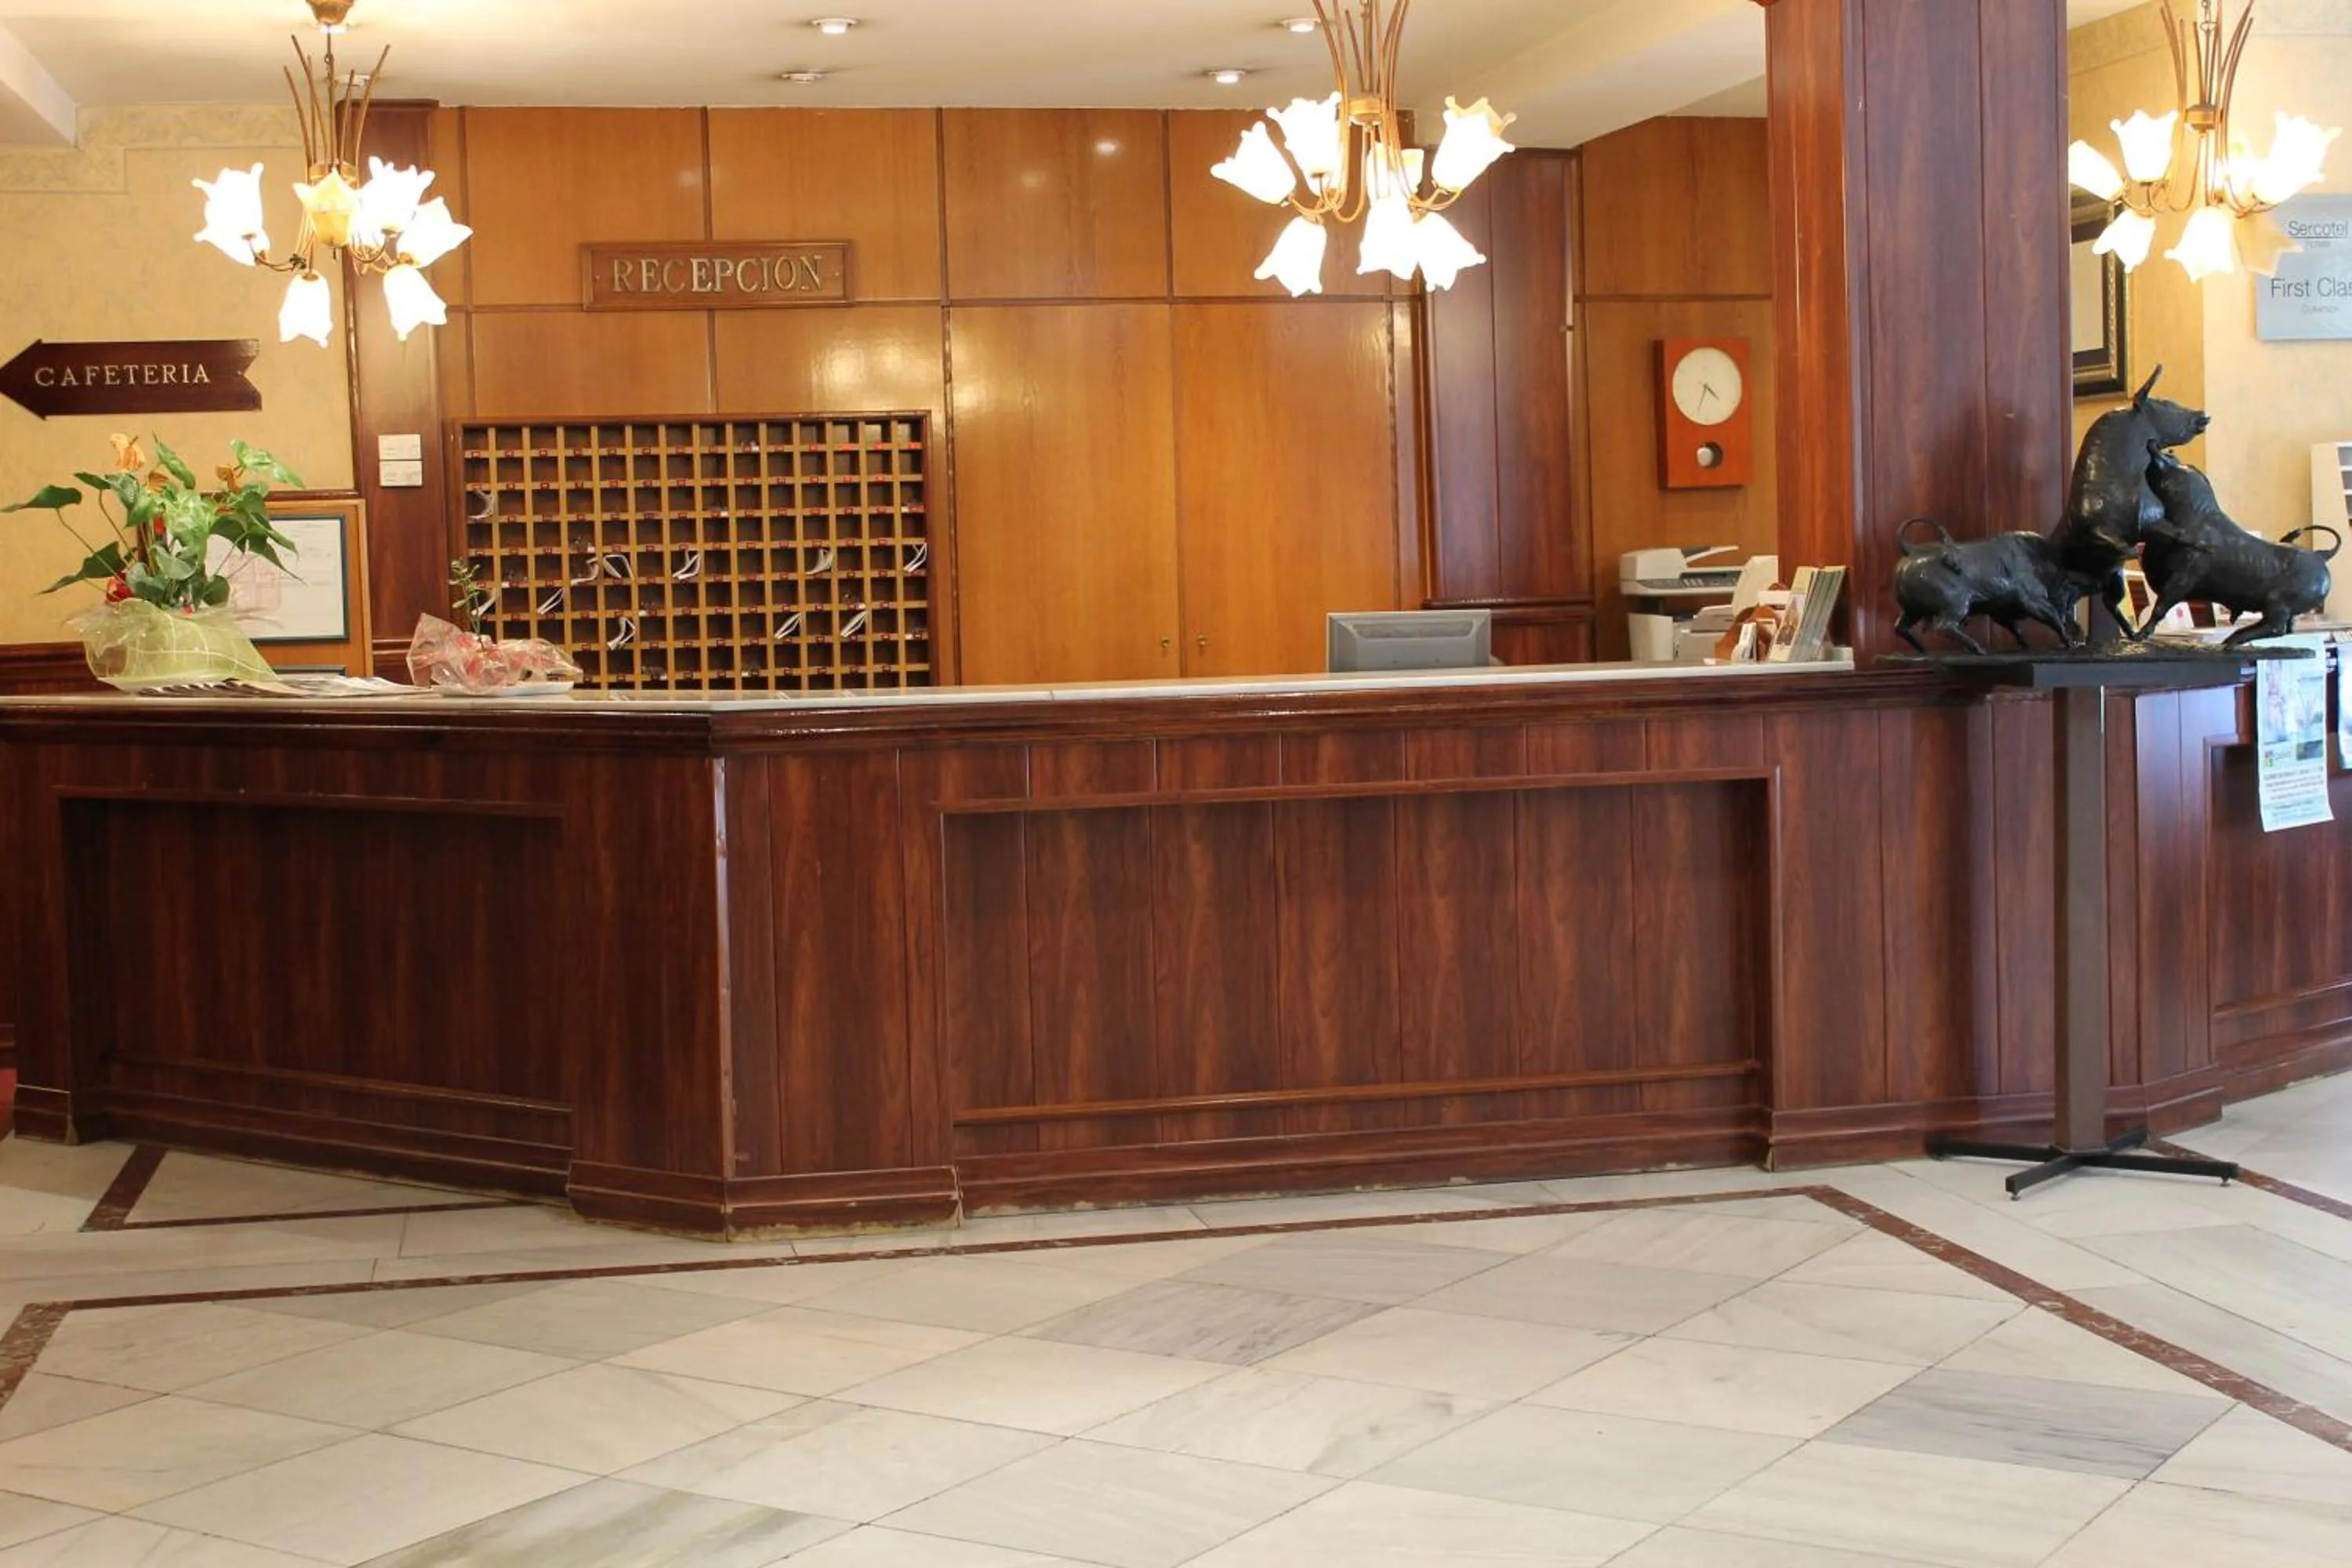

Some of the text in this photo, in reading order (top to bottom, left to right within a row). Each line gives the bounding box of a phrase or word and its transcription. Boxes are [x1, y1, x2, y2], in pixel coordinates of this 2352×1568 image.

[2288, 220, 2348, 236] Sercotel
[612, 255, 823, 292] RECEPCION
[2270, 278, 2310, 298] First
[34, 364, 211, 387] CAFETERIA
